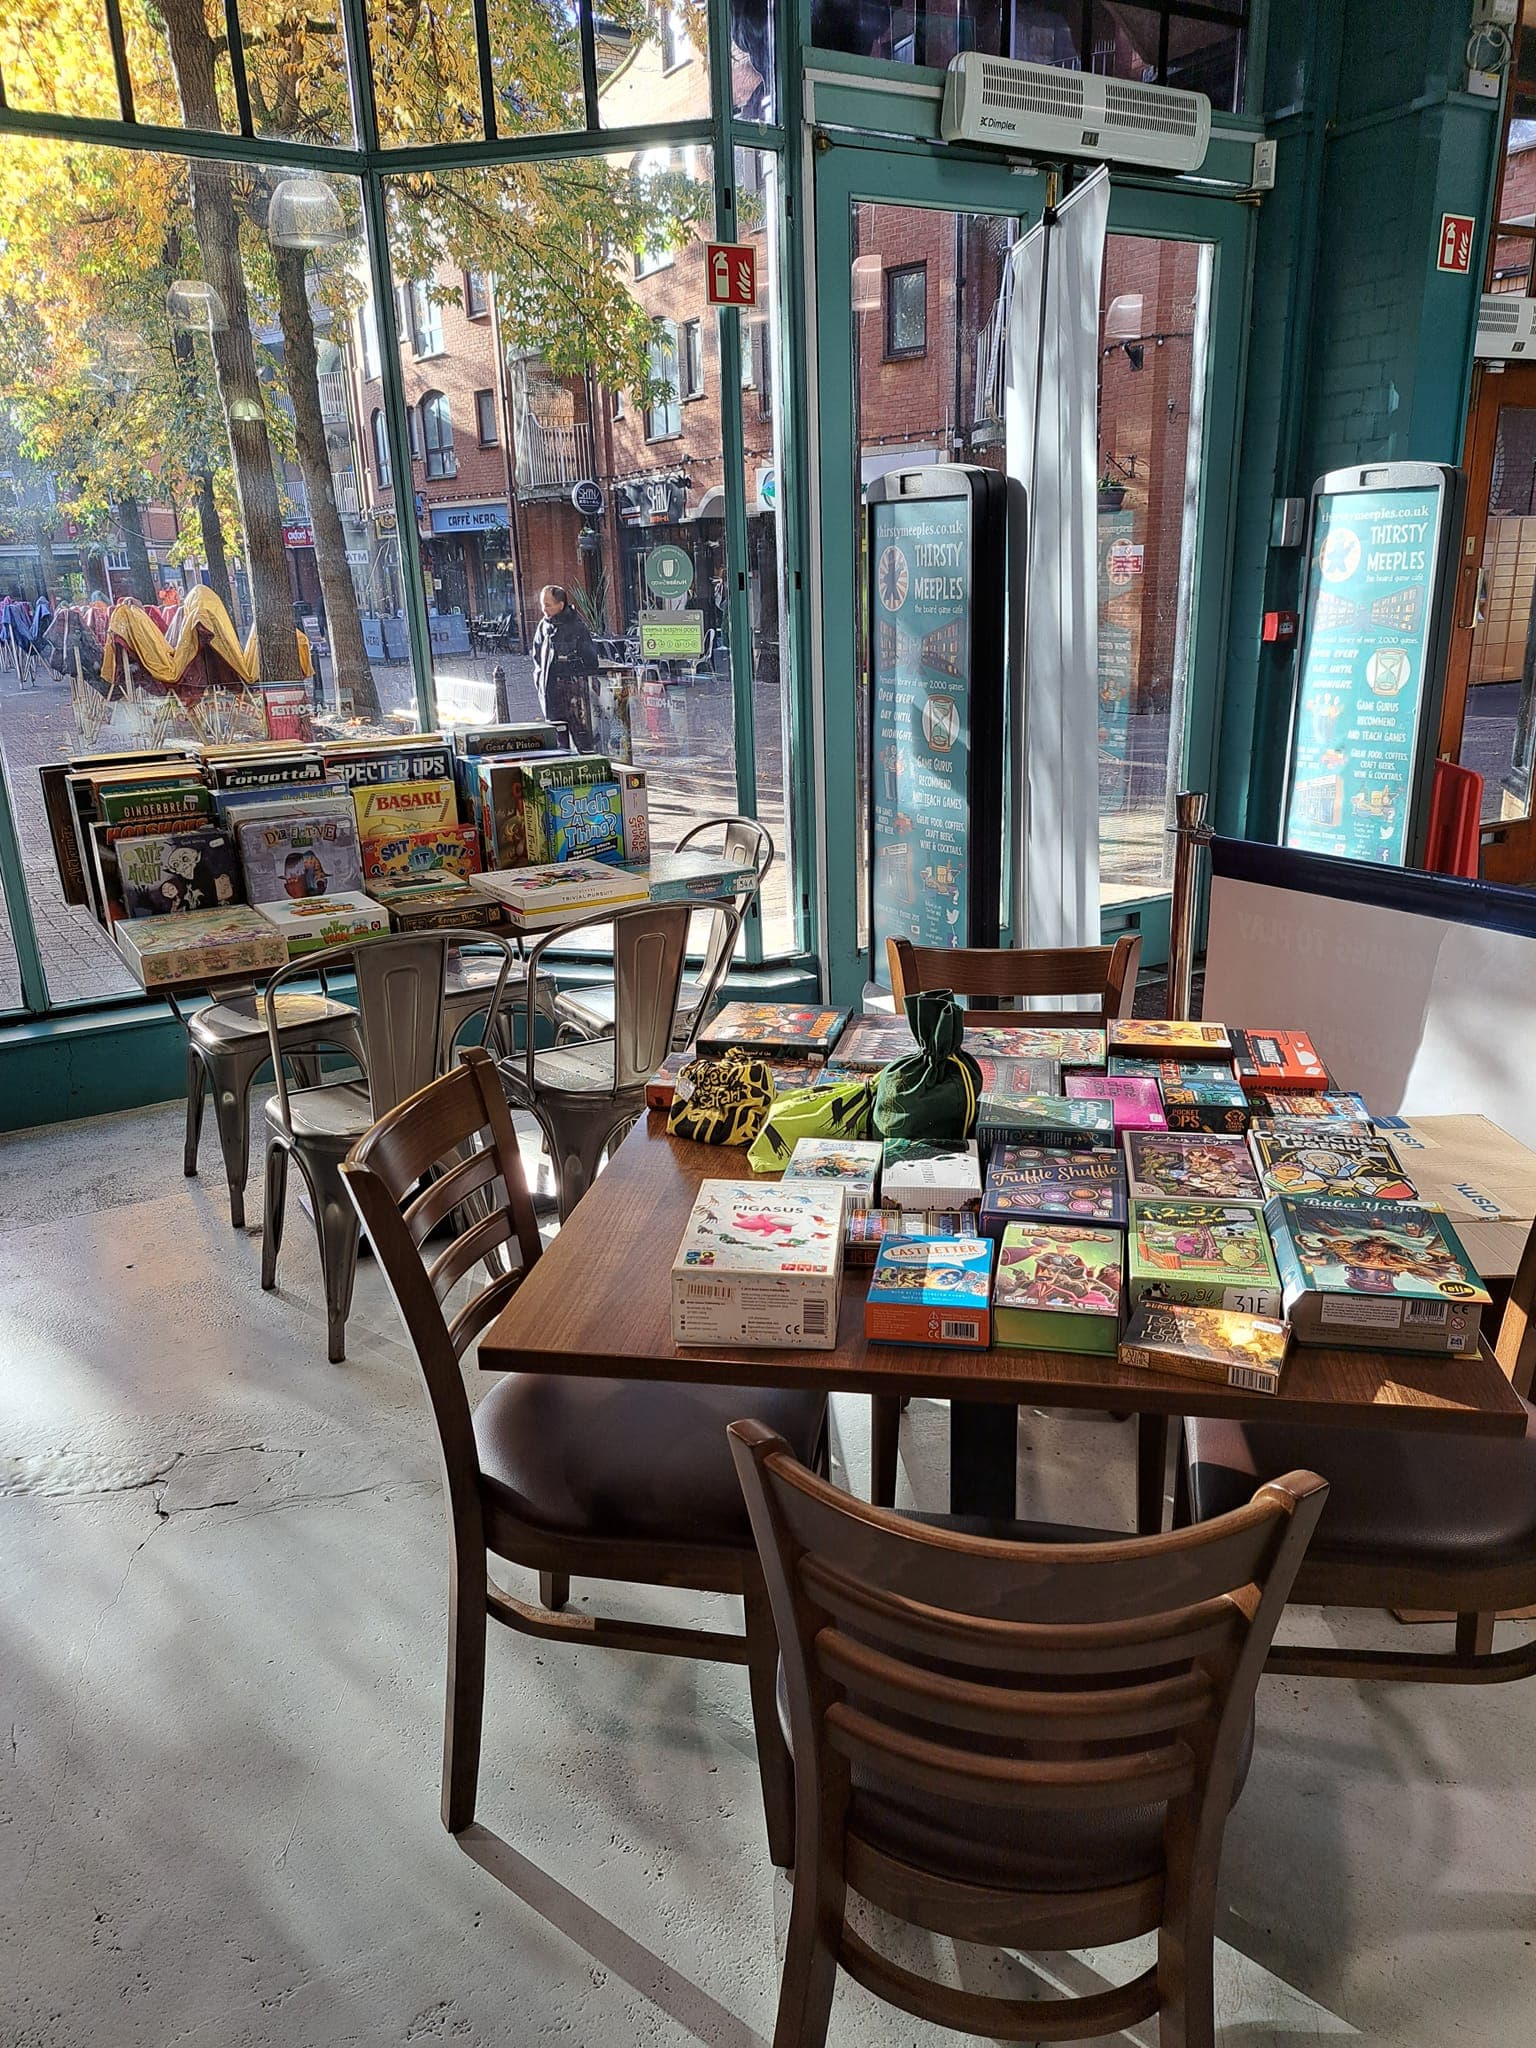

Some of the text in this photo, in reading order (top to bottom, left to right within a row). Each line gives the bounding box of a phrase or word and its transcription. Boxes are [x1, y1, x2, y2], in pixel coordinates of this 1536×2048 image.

[988, 117, 1016, 131] Dimplex
[448, 512, 496, 527] CAFFÈ NERO
[1321, 505, 1430, 524] thmeeples.co.uk
[877, 520, 963, 540] thirstymeeples.co.uk
[1371, 522, 1428, 544] THIRSTY
[346, 552, 367, 561] ATM
[914, 542, 963, 568] THIRSTY
[1367, 550, 1425, 572] MEEPLES
[1393, 575, 1410, 583] game
[914, 577, 963, 600] MEEPLES
[1334, 648, 1359, 659] EVERY
[1329, 664, 1353, 674] UNTIL
[878, 688, 914, 705] OPEN EVERY
[1356, 700, 1399, 713] GAME GURUS
[880, 710, 911, 723] DAY UNTIL
[1356, 716, 1397, 728] RECOMMEND
[1347, 730, 1407, 743] AND TEACH GAMES
[485, 743, 505, 752] Gear
[516, 741, 541, 750] Piston
[1367, 749, 1384, 760] FOOD,
[412, 755, 445, 780] OPS
[917, 756, 953, 773] GAME GURUS
[1360, 760, 1377, 770] CRAFT
[225, 769, 321, 786] Forgotten
[918, 775, 952, 790] RECOMMEND
[375, 790, 442, 811] BASARI
[559, 792, 611, 819] Such
[912, 790, 962, 810] AND TEACH GAMES
[123, 800, 197, 818] GINGERBREAD
[571, 813, 585, 827] A
[916, 813, 965, 833] GREAT FOOD, COFFEES,
[564, 813, 618, 849] Thing?
[628, 817, 640, 853] STUNDE
[636, 814, 648, 853] GEISTER
[925, 828, 939, 840] CRAFT
[435, 842, 467, 860] OUT!
[920, 839, 931, 851] WINE
[937, 843, 963, 857] COCKTAILS.
[587, 890, 614, 898] PURSUIT
[699, 1087, 741, 1110] safari
[1172, 1108, 1200, 1117] POCKET
[1167, 1114, 1201, 1128] OPS
[1141, 1134, 1190, 1144] Shadows
[1254, 1131, 1389, 1147] CONFLICTING
[1281, 1139, 1370, 1152] LEGENDS
[991, 1164, 1120, 1187] Truffle Shuffle
[732, 1204, 805, 1214] PIGASUS
[1302, 1197, 1420, 1213] Baba Yaga
[890, 1247, 921, 1258] LAST
[924, 1244, 978, 1256] LETTER
[1143, 1313, 1197, 1329] TOMB
[1140, 1330, 1188, 1345] LORD
[1146, 1325, 1186, 1340] LICH
